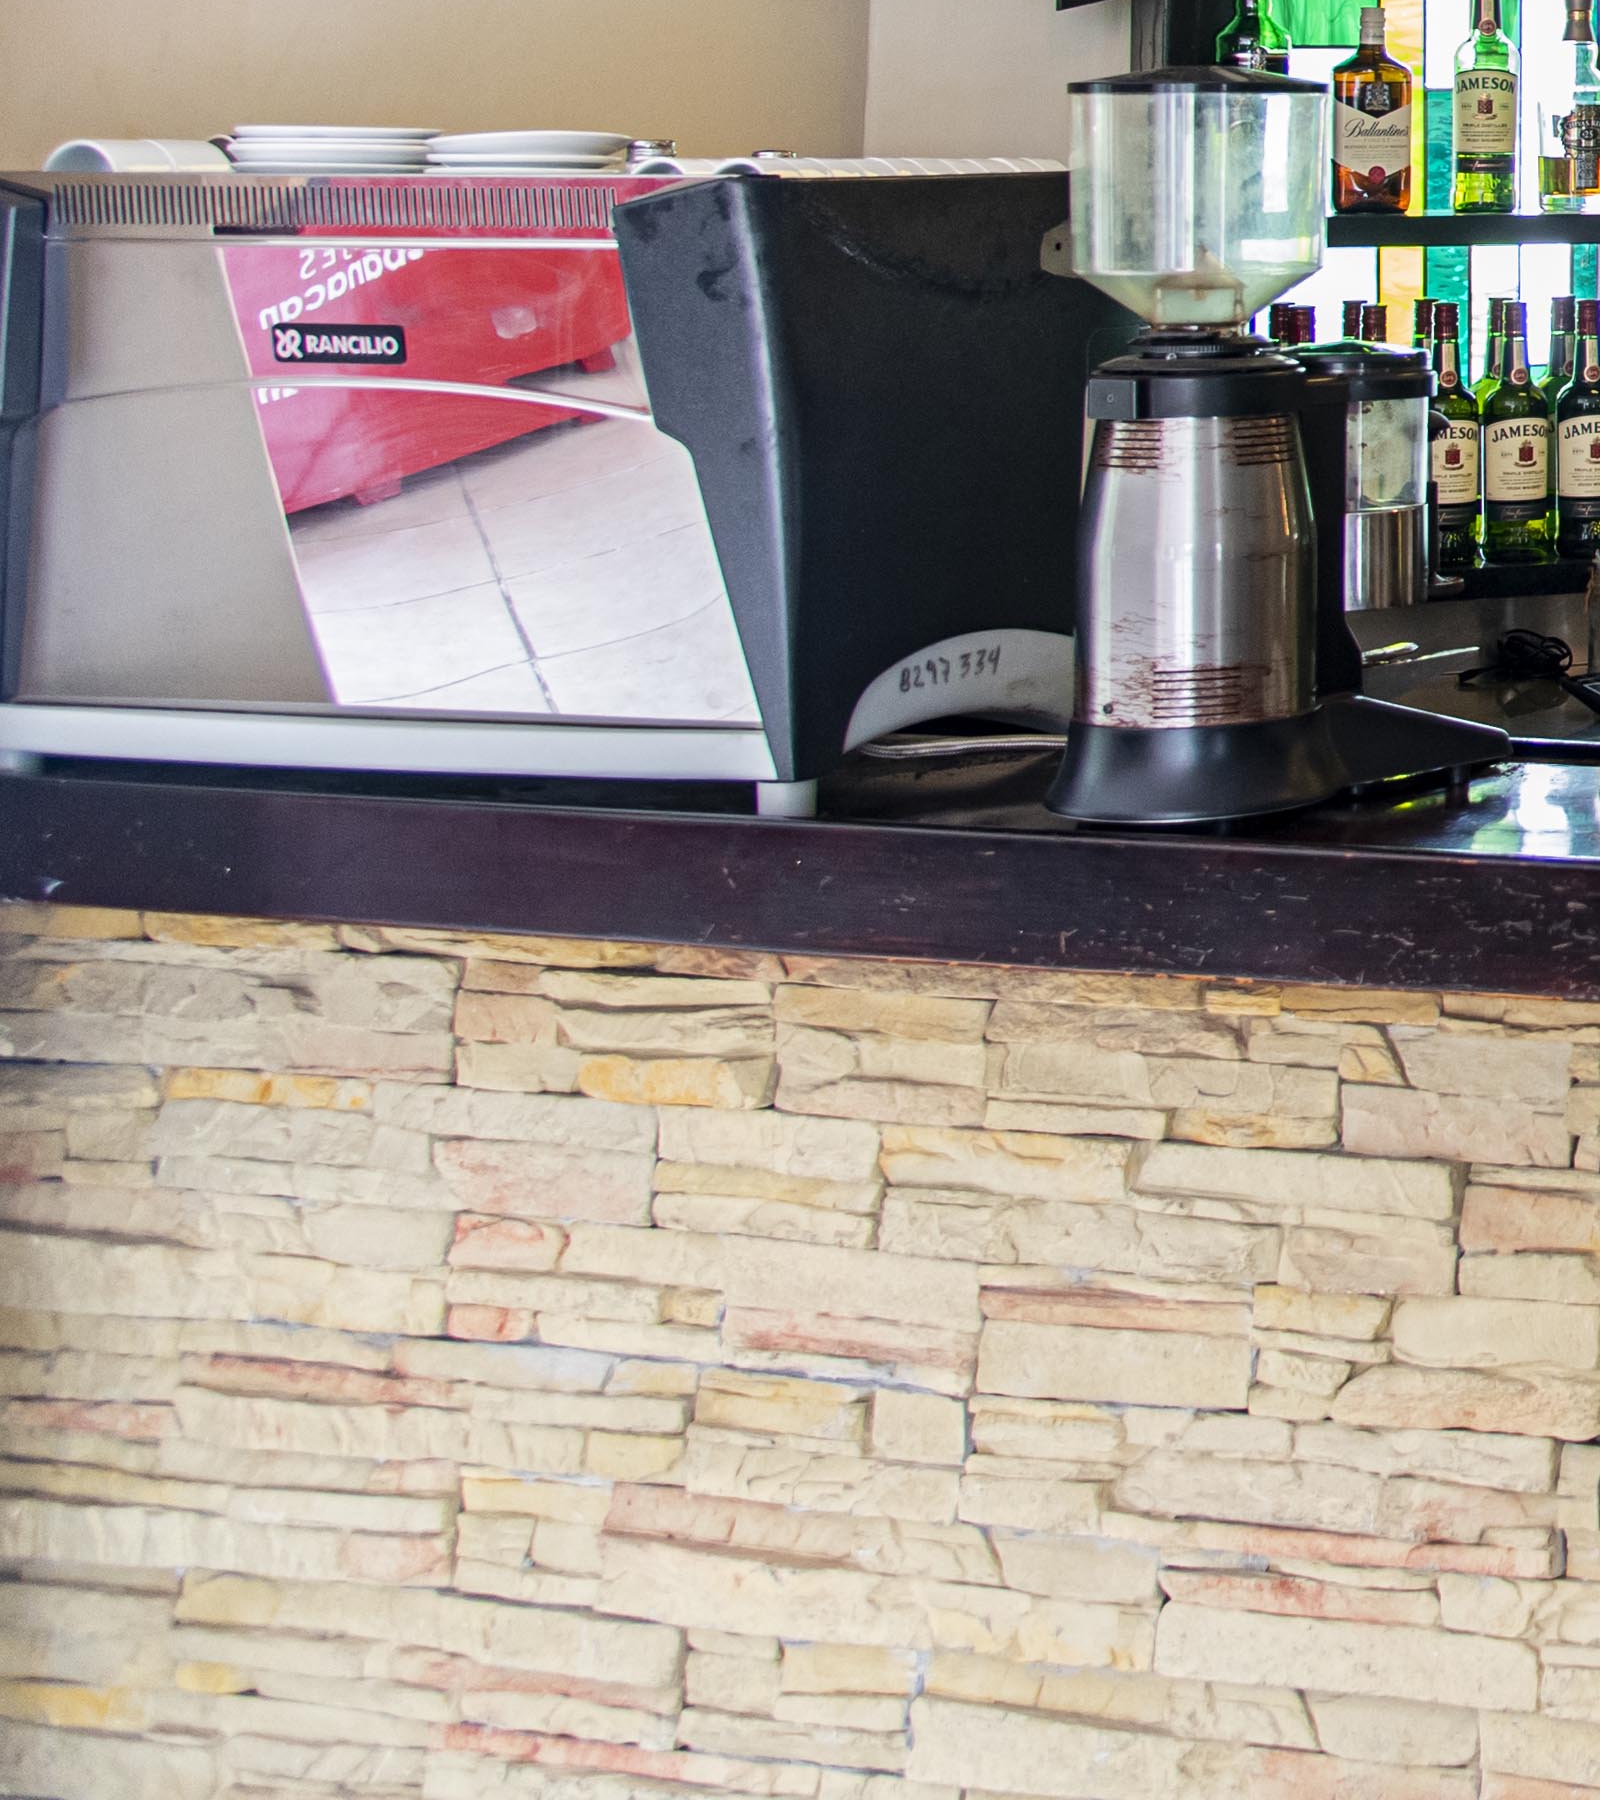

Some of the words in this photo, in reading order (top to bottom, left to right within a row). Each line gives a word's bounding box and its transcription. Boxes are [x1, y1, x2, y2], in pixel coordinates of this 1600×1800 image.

[1455, 76, 1515, 94] JAMESON
[1344, 118, 1410, 137] Ballantine's
[304, 334, 399, 356] RANCILIO
[1492, 423, 1546, 443] JAMESO
[899, 656, 951, 693] 8297
[958, 644, 1001, 679] 334
